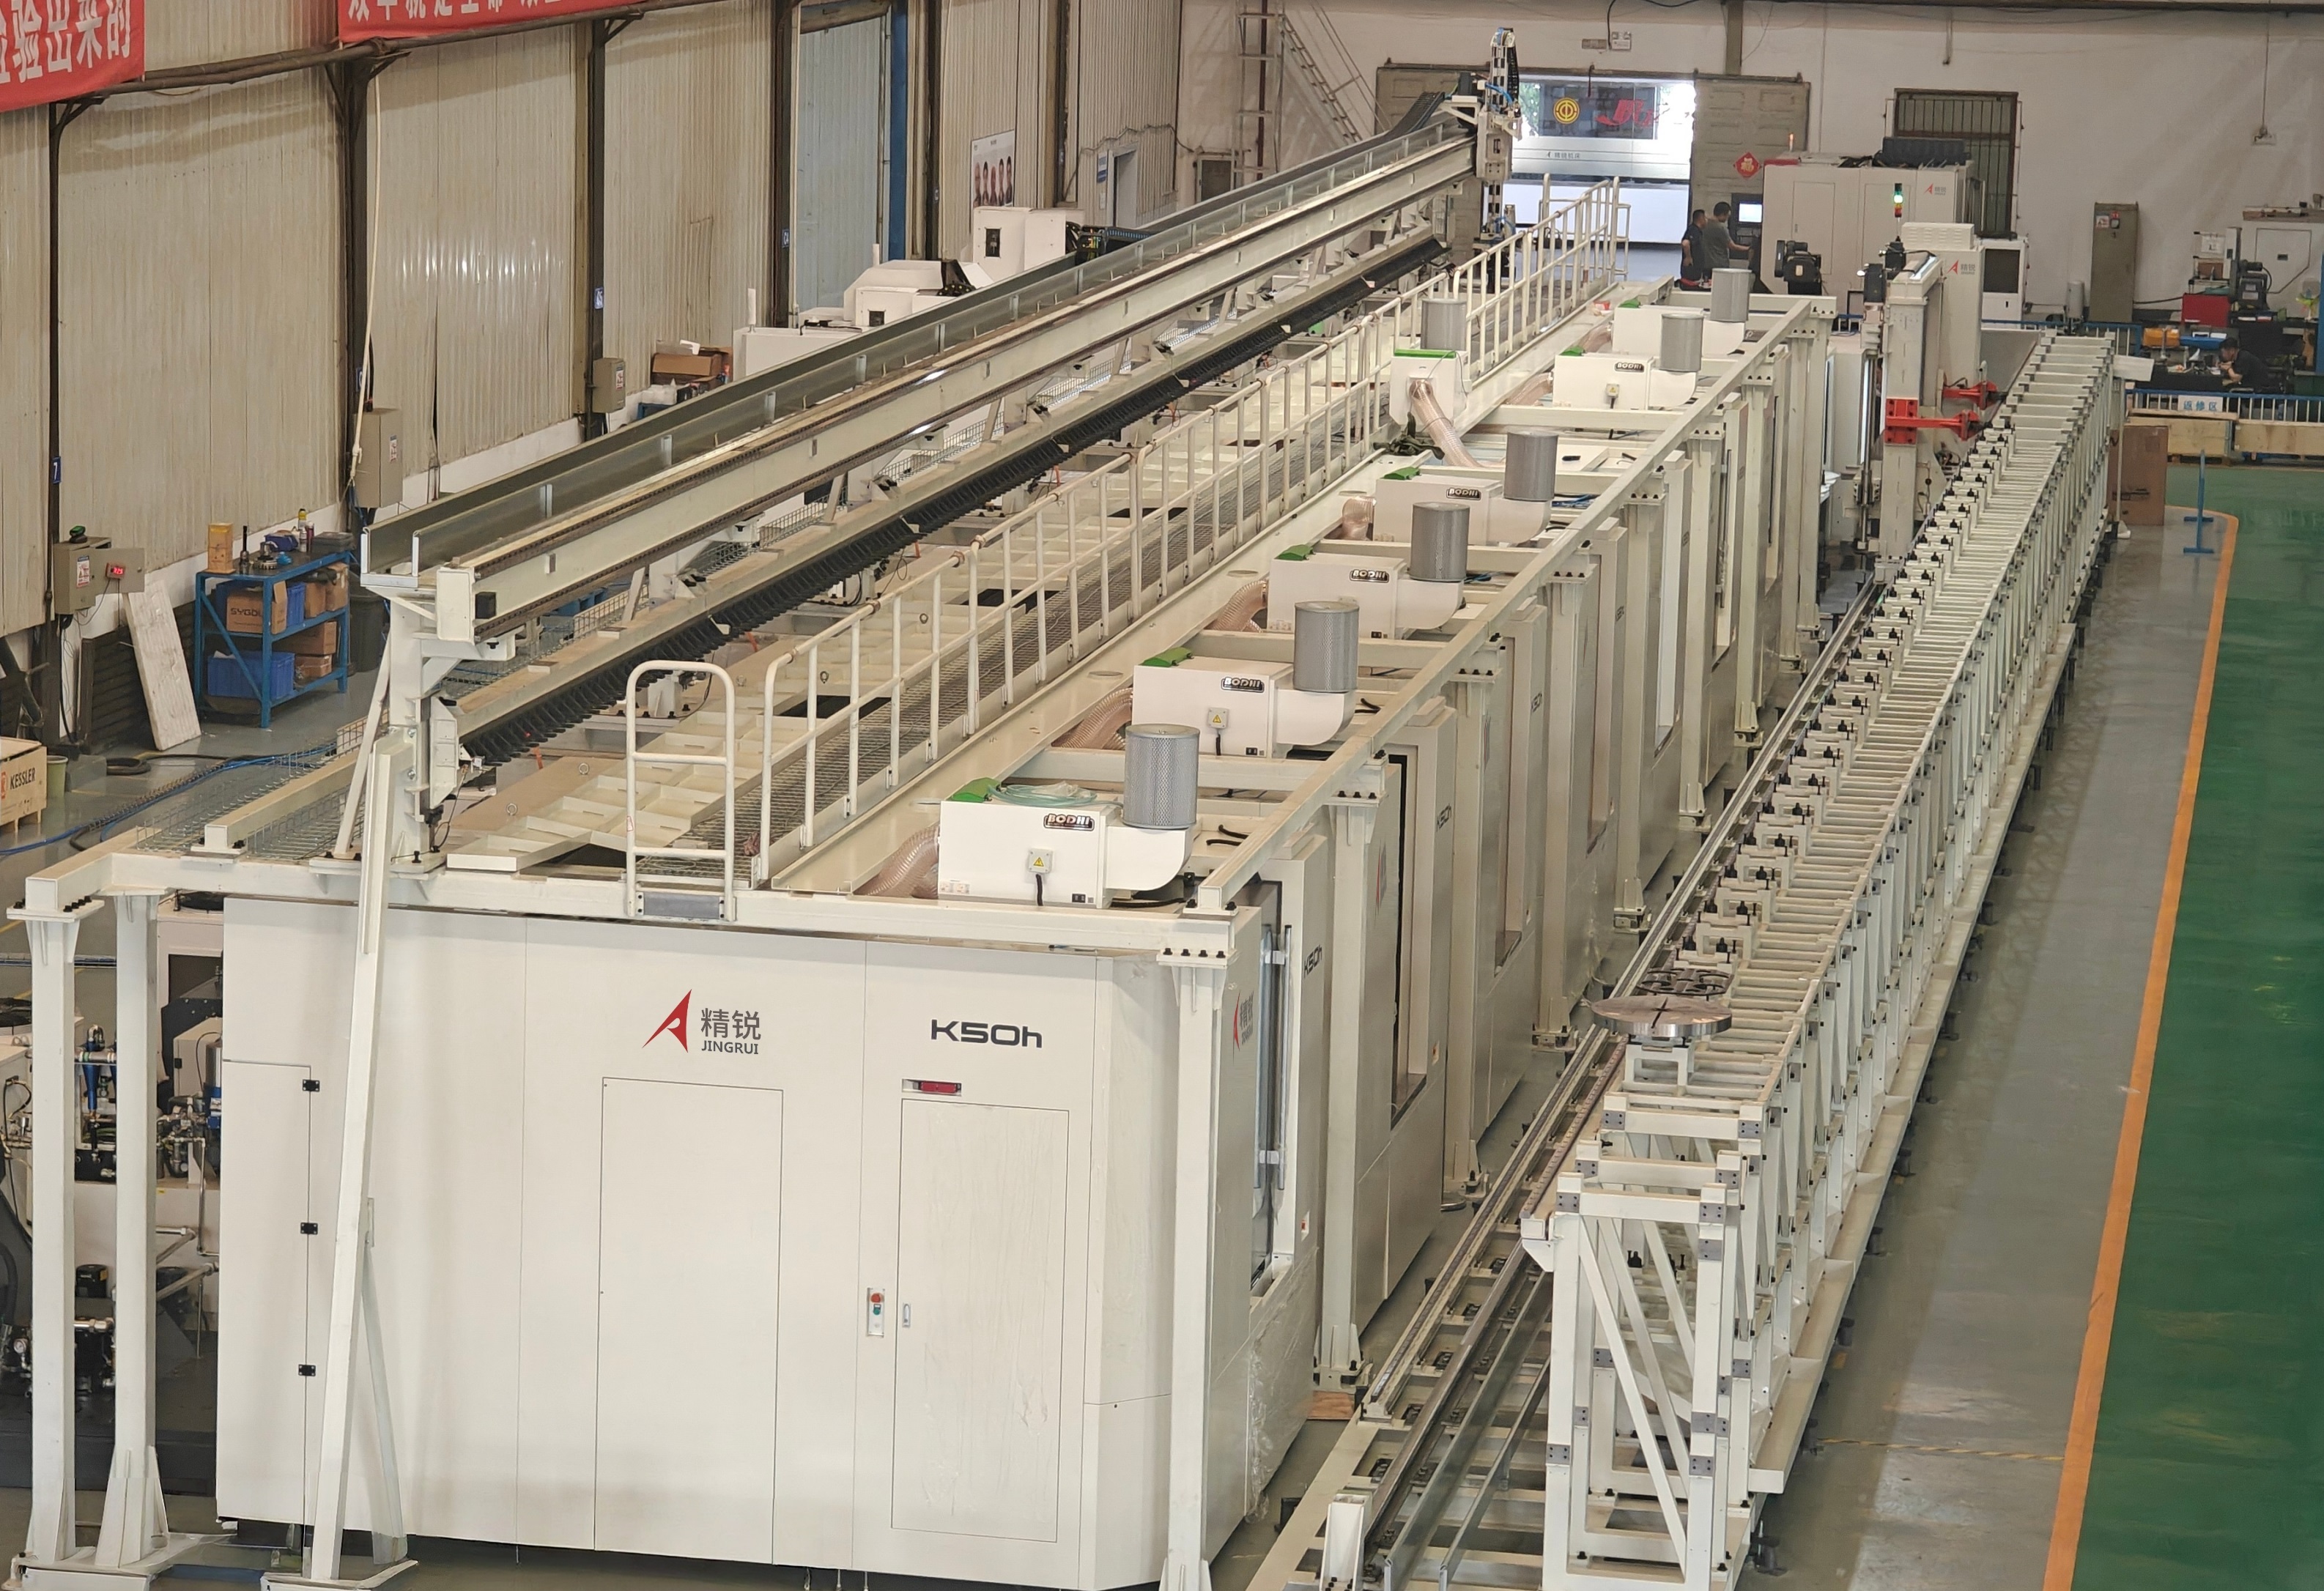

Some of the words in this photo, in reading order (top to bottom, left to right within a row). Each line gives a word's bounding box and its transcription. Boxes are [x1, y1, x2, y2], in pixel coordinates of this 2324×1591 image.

[10, 767, 35, 790] KESSLER
[1047, 813, 1091, 825] BODHI
[700, 1007, 761, 1040] 精锐
[930, 1019, 1042, 1048] K50h
[701, 1039, 759, 1055] JINGRUI
